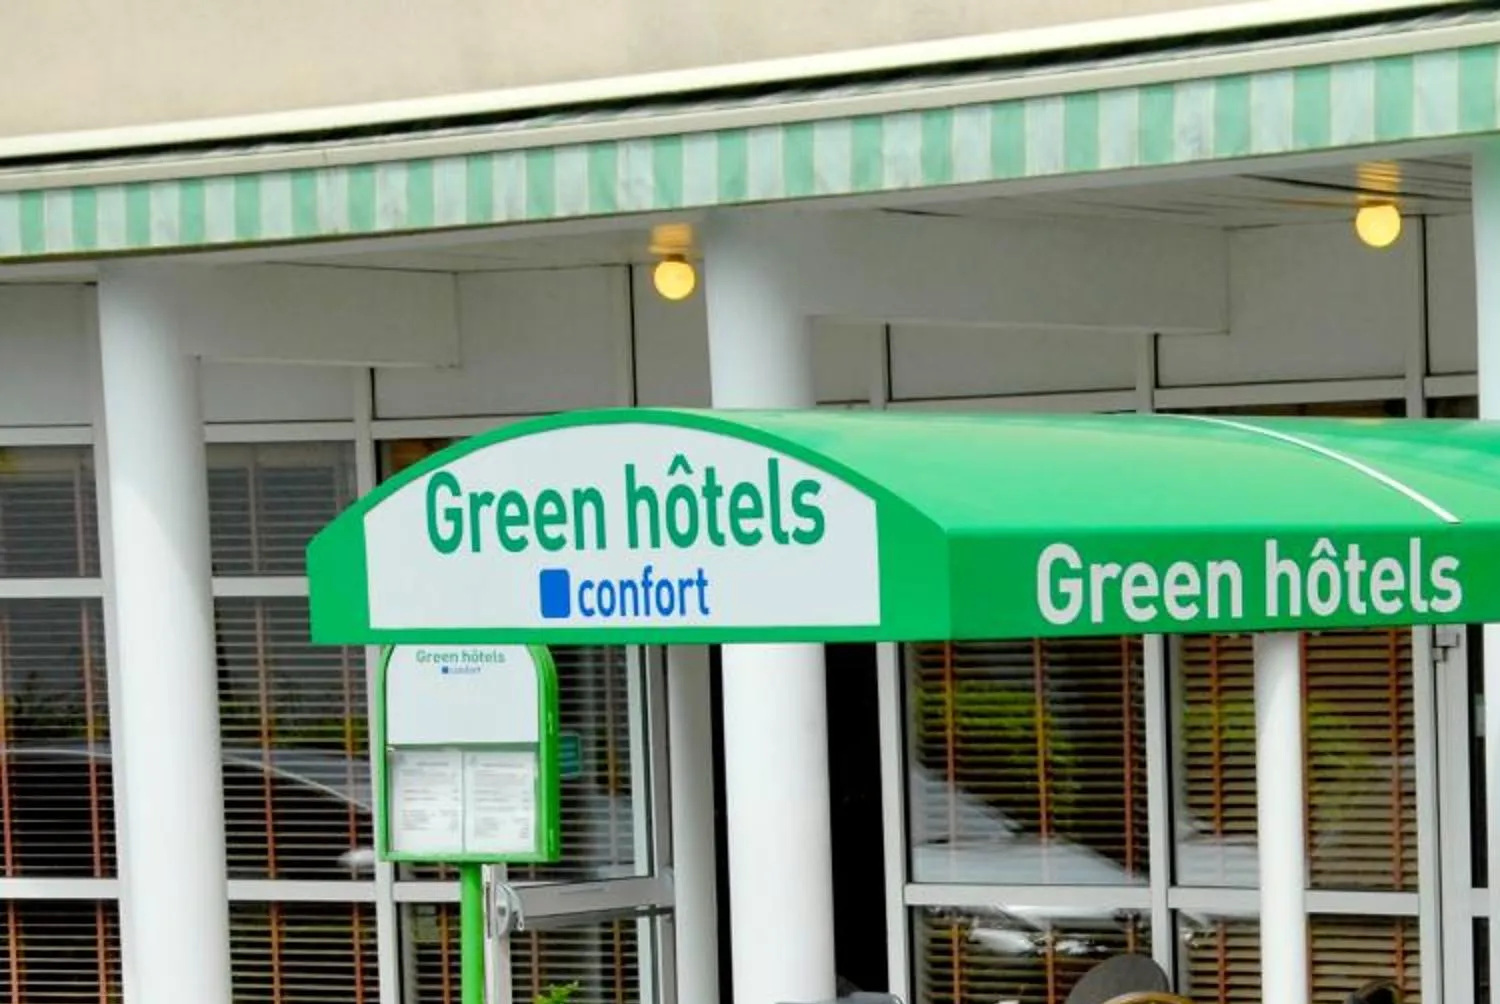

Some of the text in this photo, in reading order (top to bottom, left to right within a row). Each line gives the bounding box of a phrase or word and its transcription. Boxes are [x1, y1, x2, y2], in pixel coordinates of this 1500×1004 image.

[426, 453, 826, 554] Green hôtels
[577, 565, 710, 618] confort
[1035, 537, 1463, 625] Green hôtels
[415, 648, 506, 664] Green hôtels
